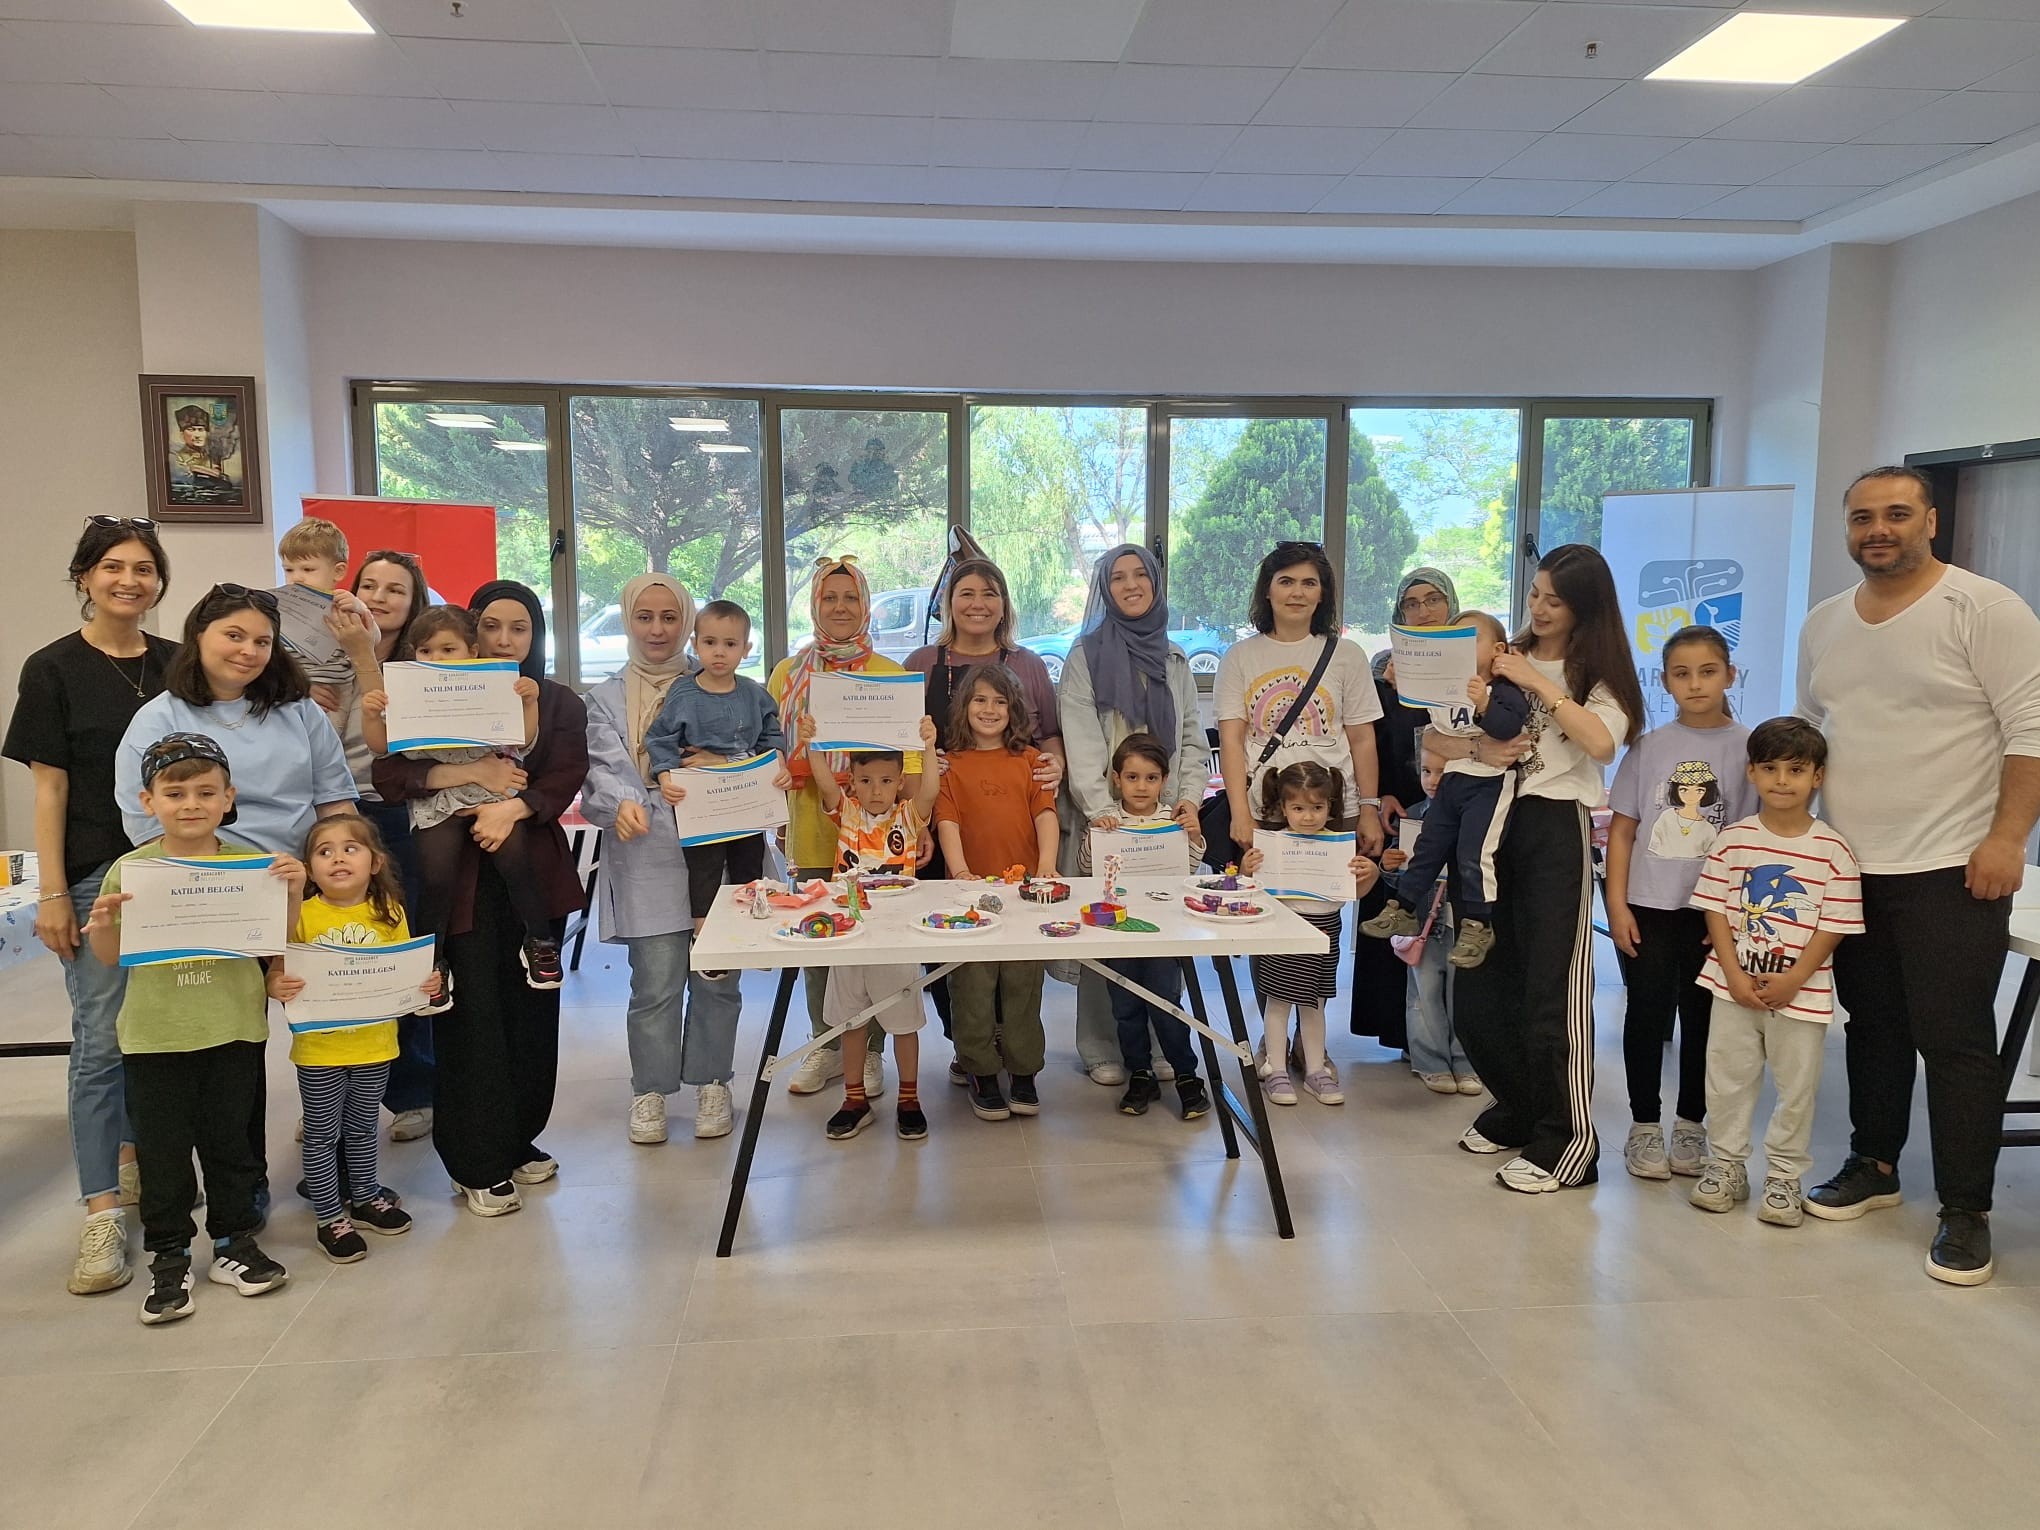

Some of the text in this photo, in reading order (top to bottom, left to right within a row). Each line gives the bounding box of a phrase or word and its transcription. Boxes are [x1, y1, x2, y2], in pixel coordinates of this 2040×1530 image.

[423, 685, 453, 693] KATILIM
[171, 883, 244, 896] KATILIM BELGESİ
[327, 962, 397, 977] KATILIM BELGESİ
[176, 970, 213, 988] NATURE
